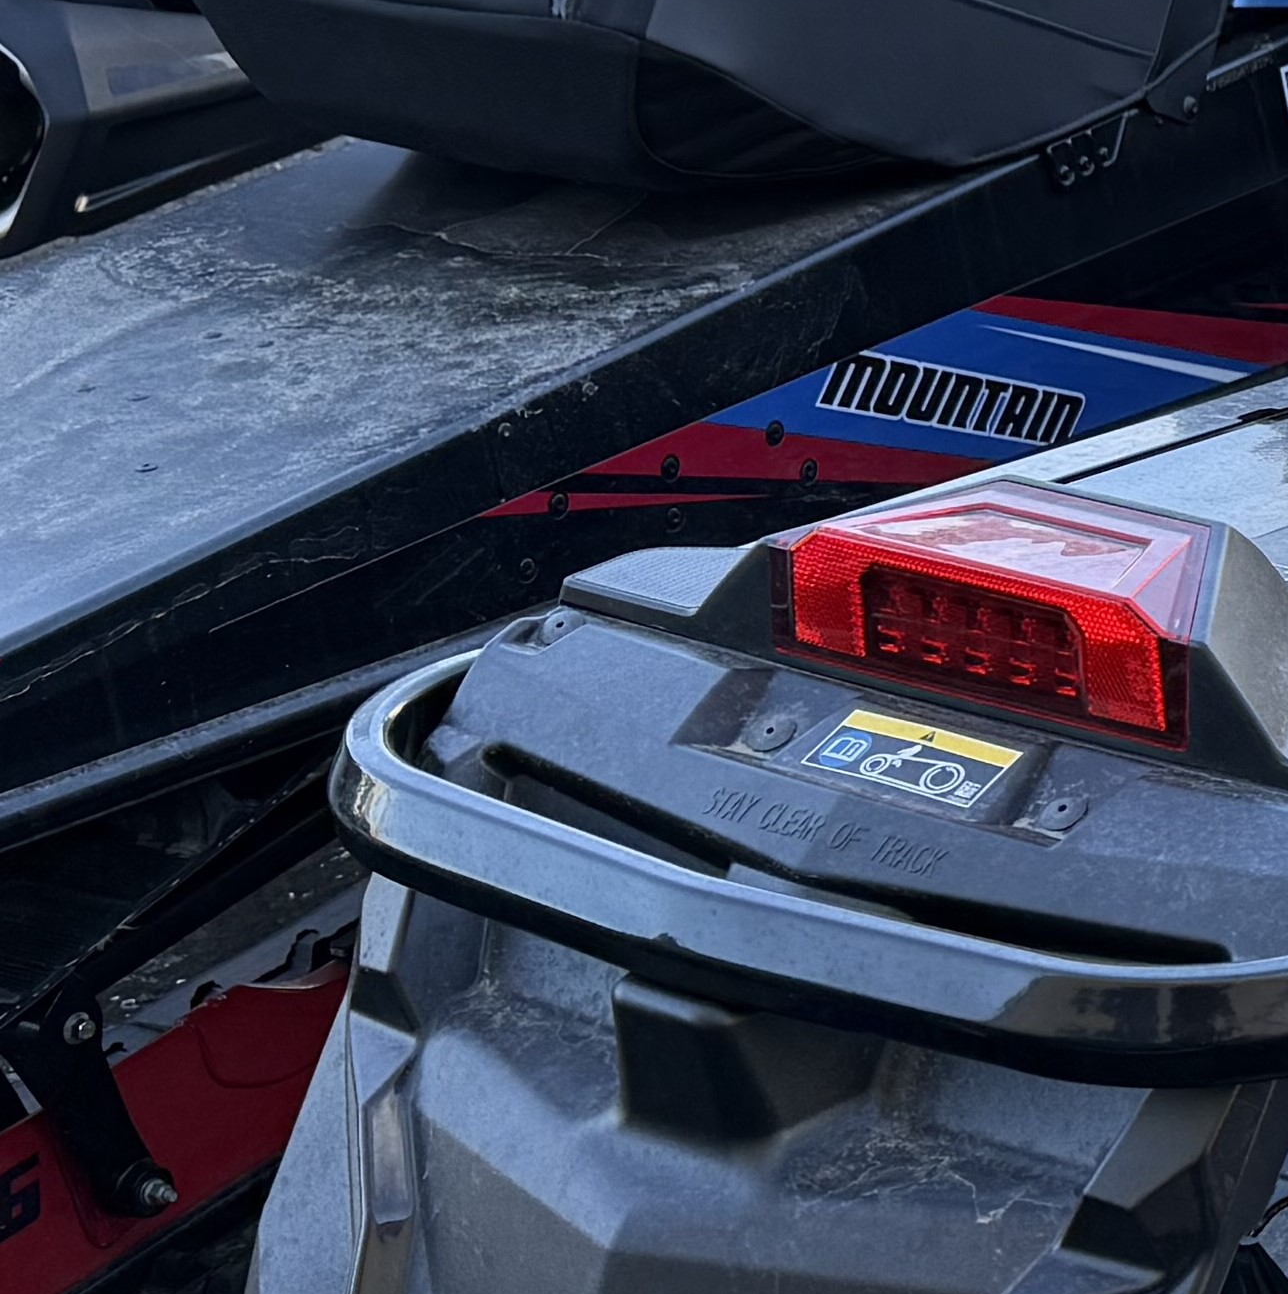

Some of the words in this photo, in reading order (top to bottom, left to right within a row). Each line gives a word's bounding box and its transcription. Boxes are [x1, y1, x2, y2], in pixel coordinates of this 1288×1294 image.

[815, 348, 1086, 447] MOUNTAIN
[702, 787, 763, 824] STAY
[758, 802, 829, 843] CLEAR
[827, 821, 872, 852] OF
[870, 834, 950, 879] TRACK
